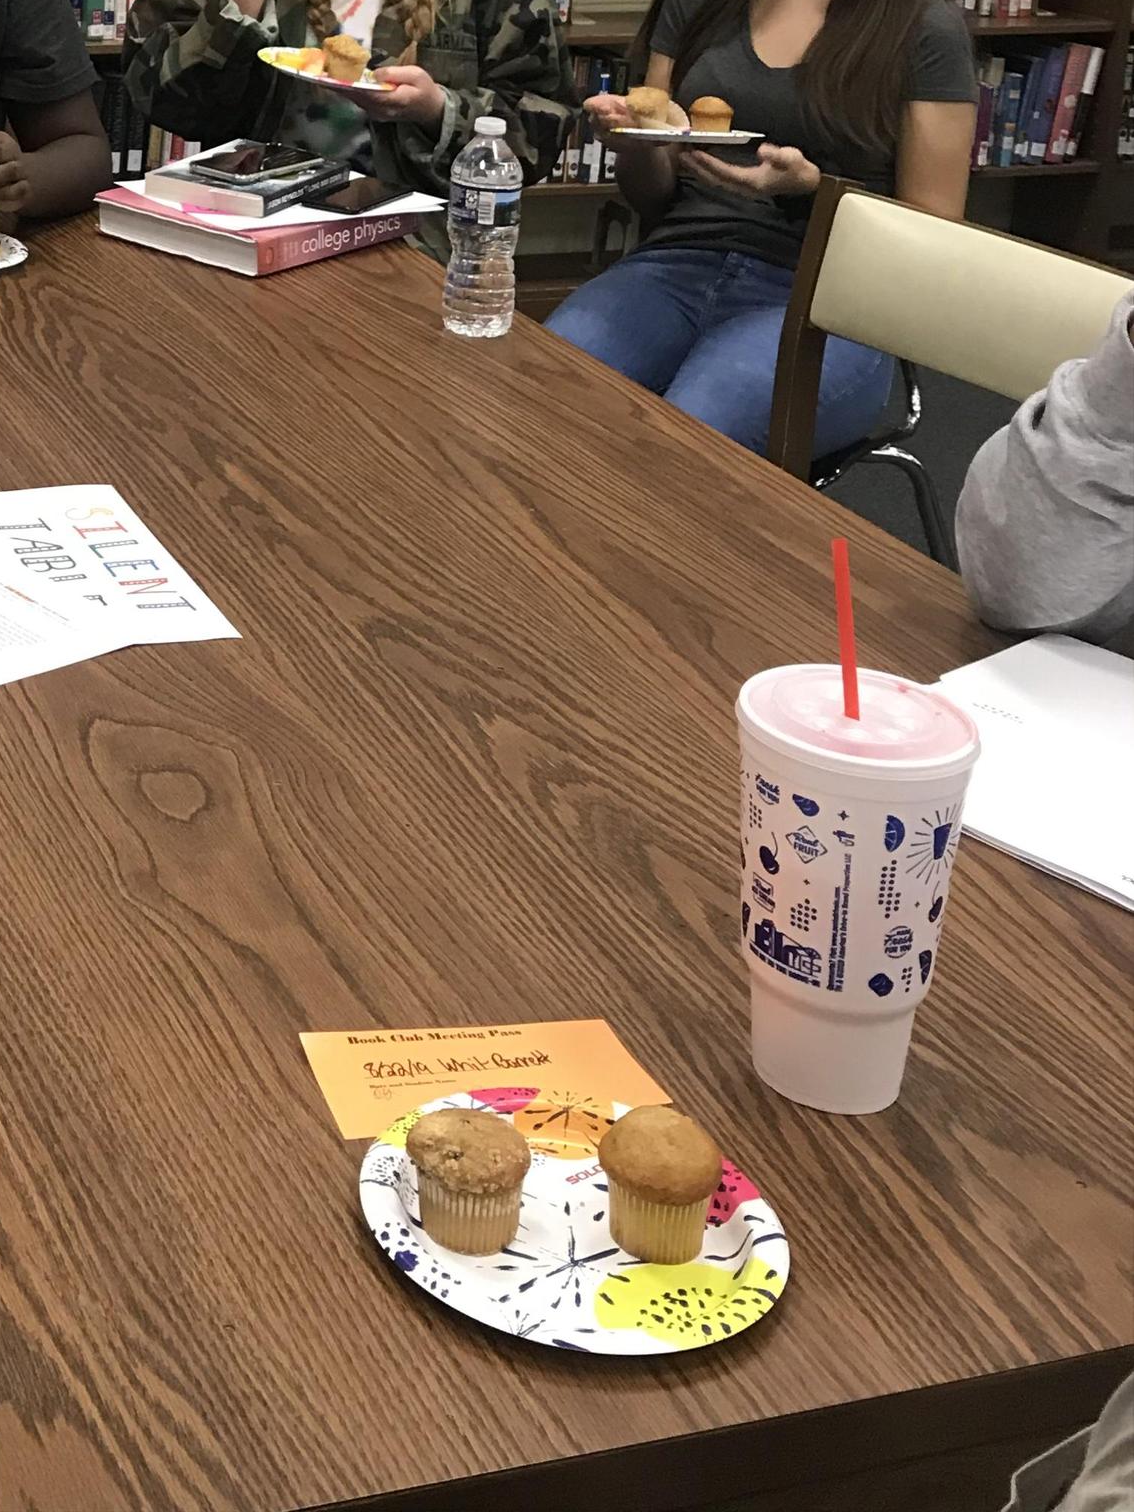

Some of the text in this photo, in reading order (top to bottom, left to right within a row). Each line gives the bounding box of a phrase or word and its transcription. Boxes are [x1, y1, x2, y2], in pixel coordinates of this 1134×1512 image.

[301, 216, 402, 254] college physics
[66, 506, 197, 613] SILENT
[793, 842, 820, 857] FRUIT
[347, 1029, 523, 1045] Book Club Meeting Pass
